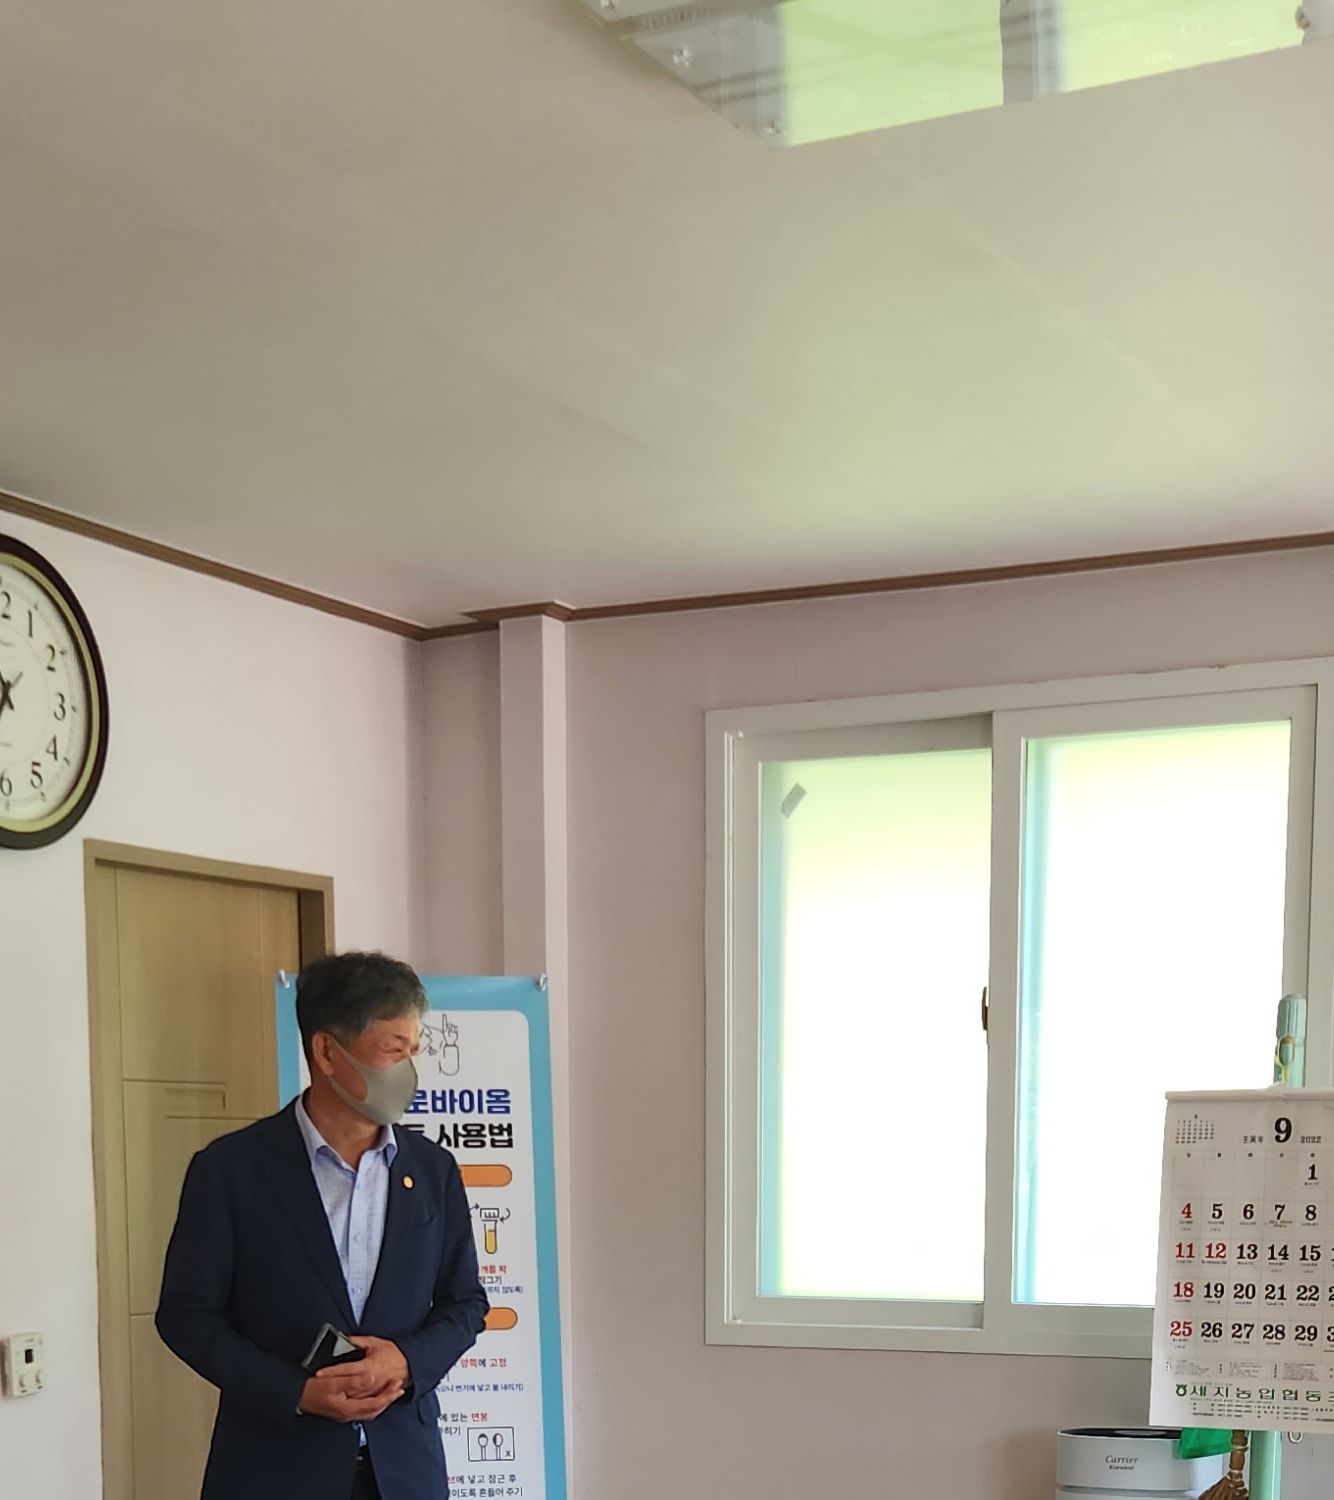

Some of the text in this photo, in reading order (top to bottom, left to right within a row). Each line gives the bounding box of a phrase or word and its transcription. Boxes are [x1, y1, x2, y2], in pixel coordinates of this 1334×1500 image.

[27, 609, 34, 638] 1
[46, 644, 56, 672] 2
[53, 692, 66, 721] 3
[46, 735, 58, 761] 4
[0, 768, 12, 796] 6
[30, 761, 43, 789] 5
[436, 1123, 513, 1149] 사용법
[1274, 1117, 1292, 1144] 9
[1300, 1135, 1322, 1144] 2022
[1308, 1164, 1318, 1181] 1
[1181, 1203, 1193, 1219] 4
[1211, 1203, 1223, 1220] 5
[1243, 1204, 1254, 1220] 6
[1274, 1204, 1286, 1220] 7
[1305, 1205, 1317, 1221] 8
[1175, 1242, 1196, 1259] 11
[1204, 1243, 1227, 1259] 12
[1236, 1243, 1258, 1260] 13
[1267, 1244, 1289, 1261] 14
[1299, 1244, 1322, 1262] 15
[1173, 1281, 1194, 1298] 18
[1203, 1282, 1225, 1299] 19
[1233, 1283, 1256, 1300] 20
[1264, 1283, 1287, 1301] 21
[1296, 1285, 1320, 1302] 22
[1170, 1321, 1193, 1337] 25
[1201, 1322, 1223, 1339] 26
[1231, 1323, 1255, 1340] 27
[1262, 1323, 1286, 1341] 28
[1294, 1325, 1318, 1342] 29
[1105, 1455, 1139, 1464] Carrier
[449, 1488, 476, 1498] 이도록
[506, 1486, 523, 1497] 주기
